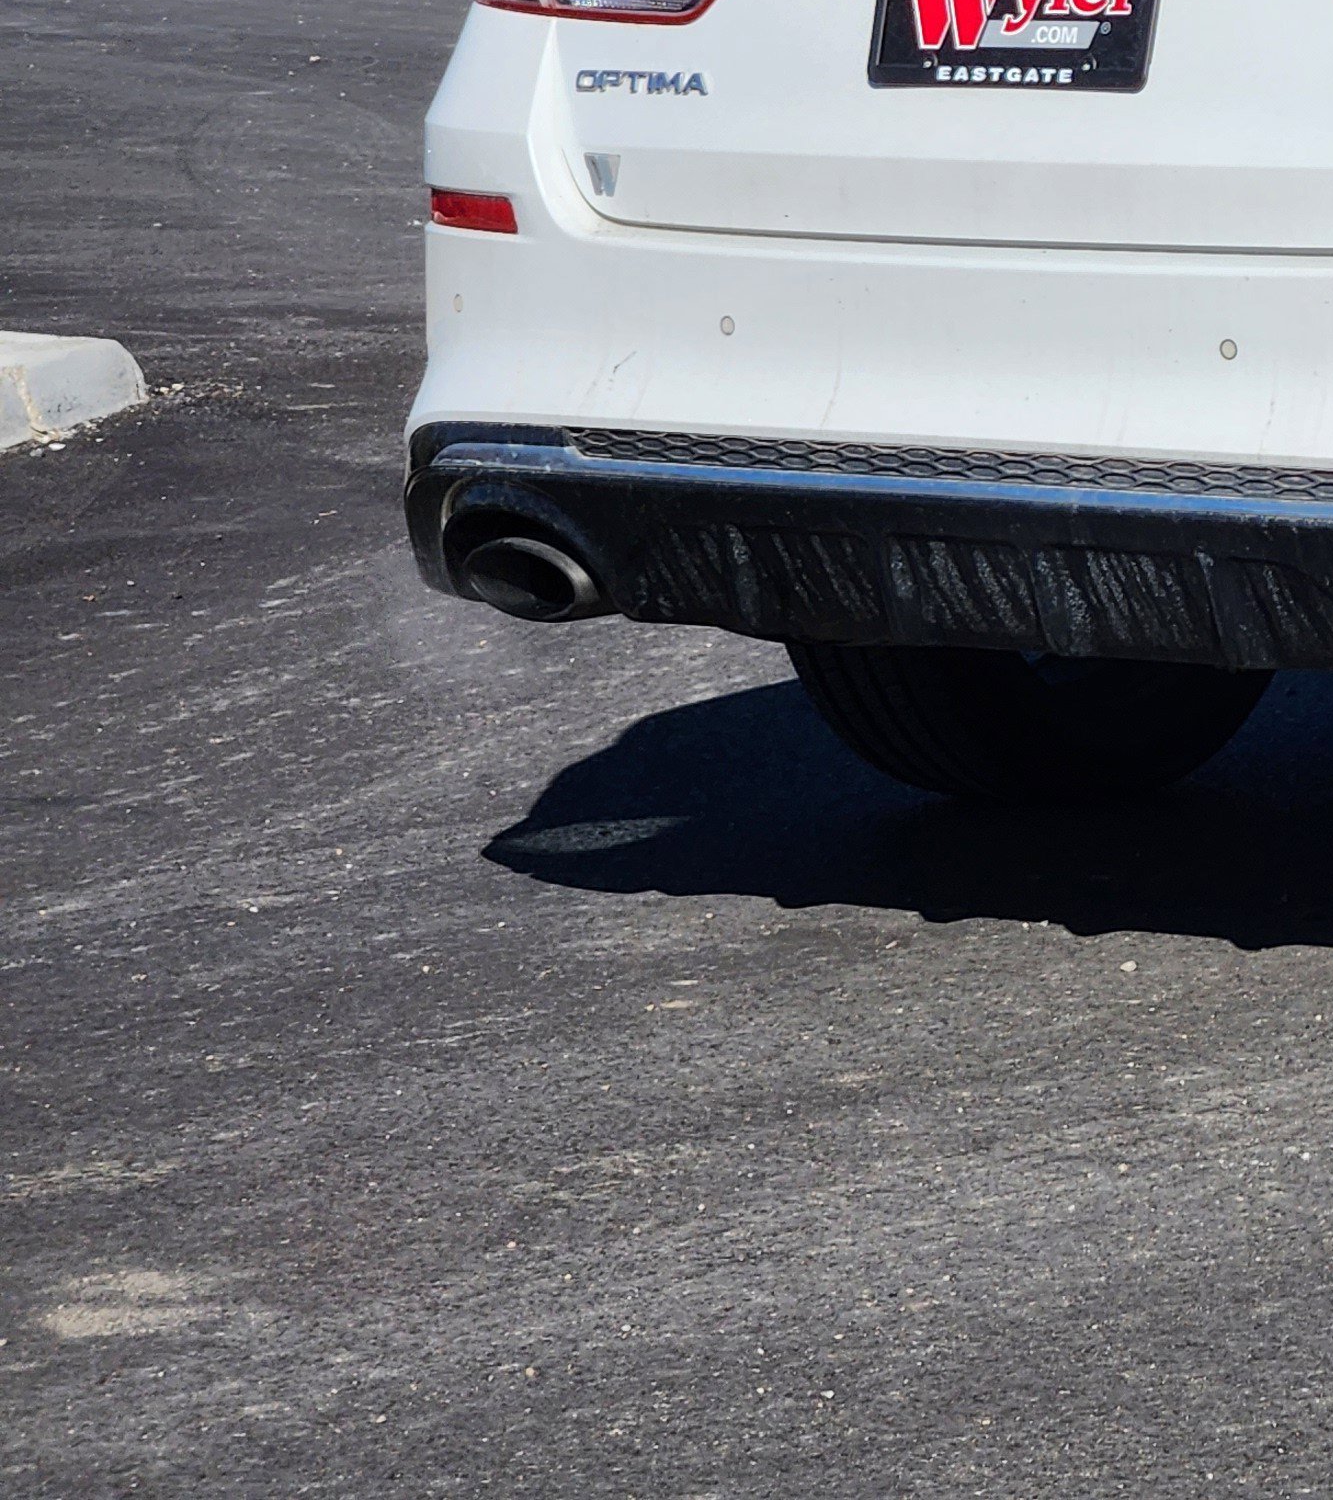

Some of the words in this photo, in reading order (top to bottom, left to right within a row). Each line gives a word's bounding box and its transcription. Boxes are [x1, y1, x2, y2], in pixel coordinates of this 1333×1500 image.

[1031, 26, 1078, 44] .COM
[575, 69, 709, 96] OPTIMA
[935, 64, 1074, 84] EASTGATE
